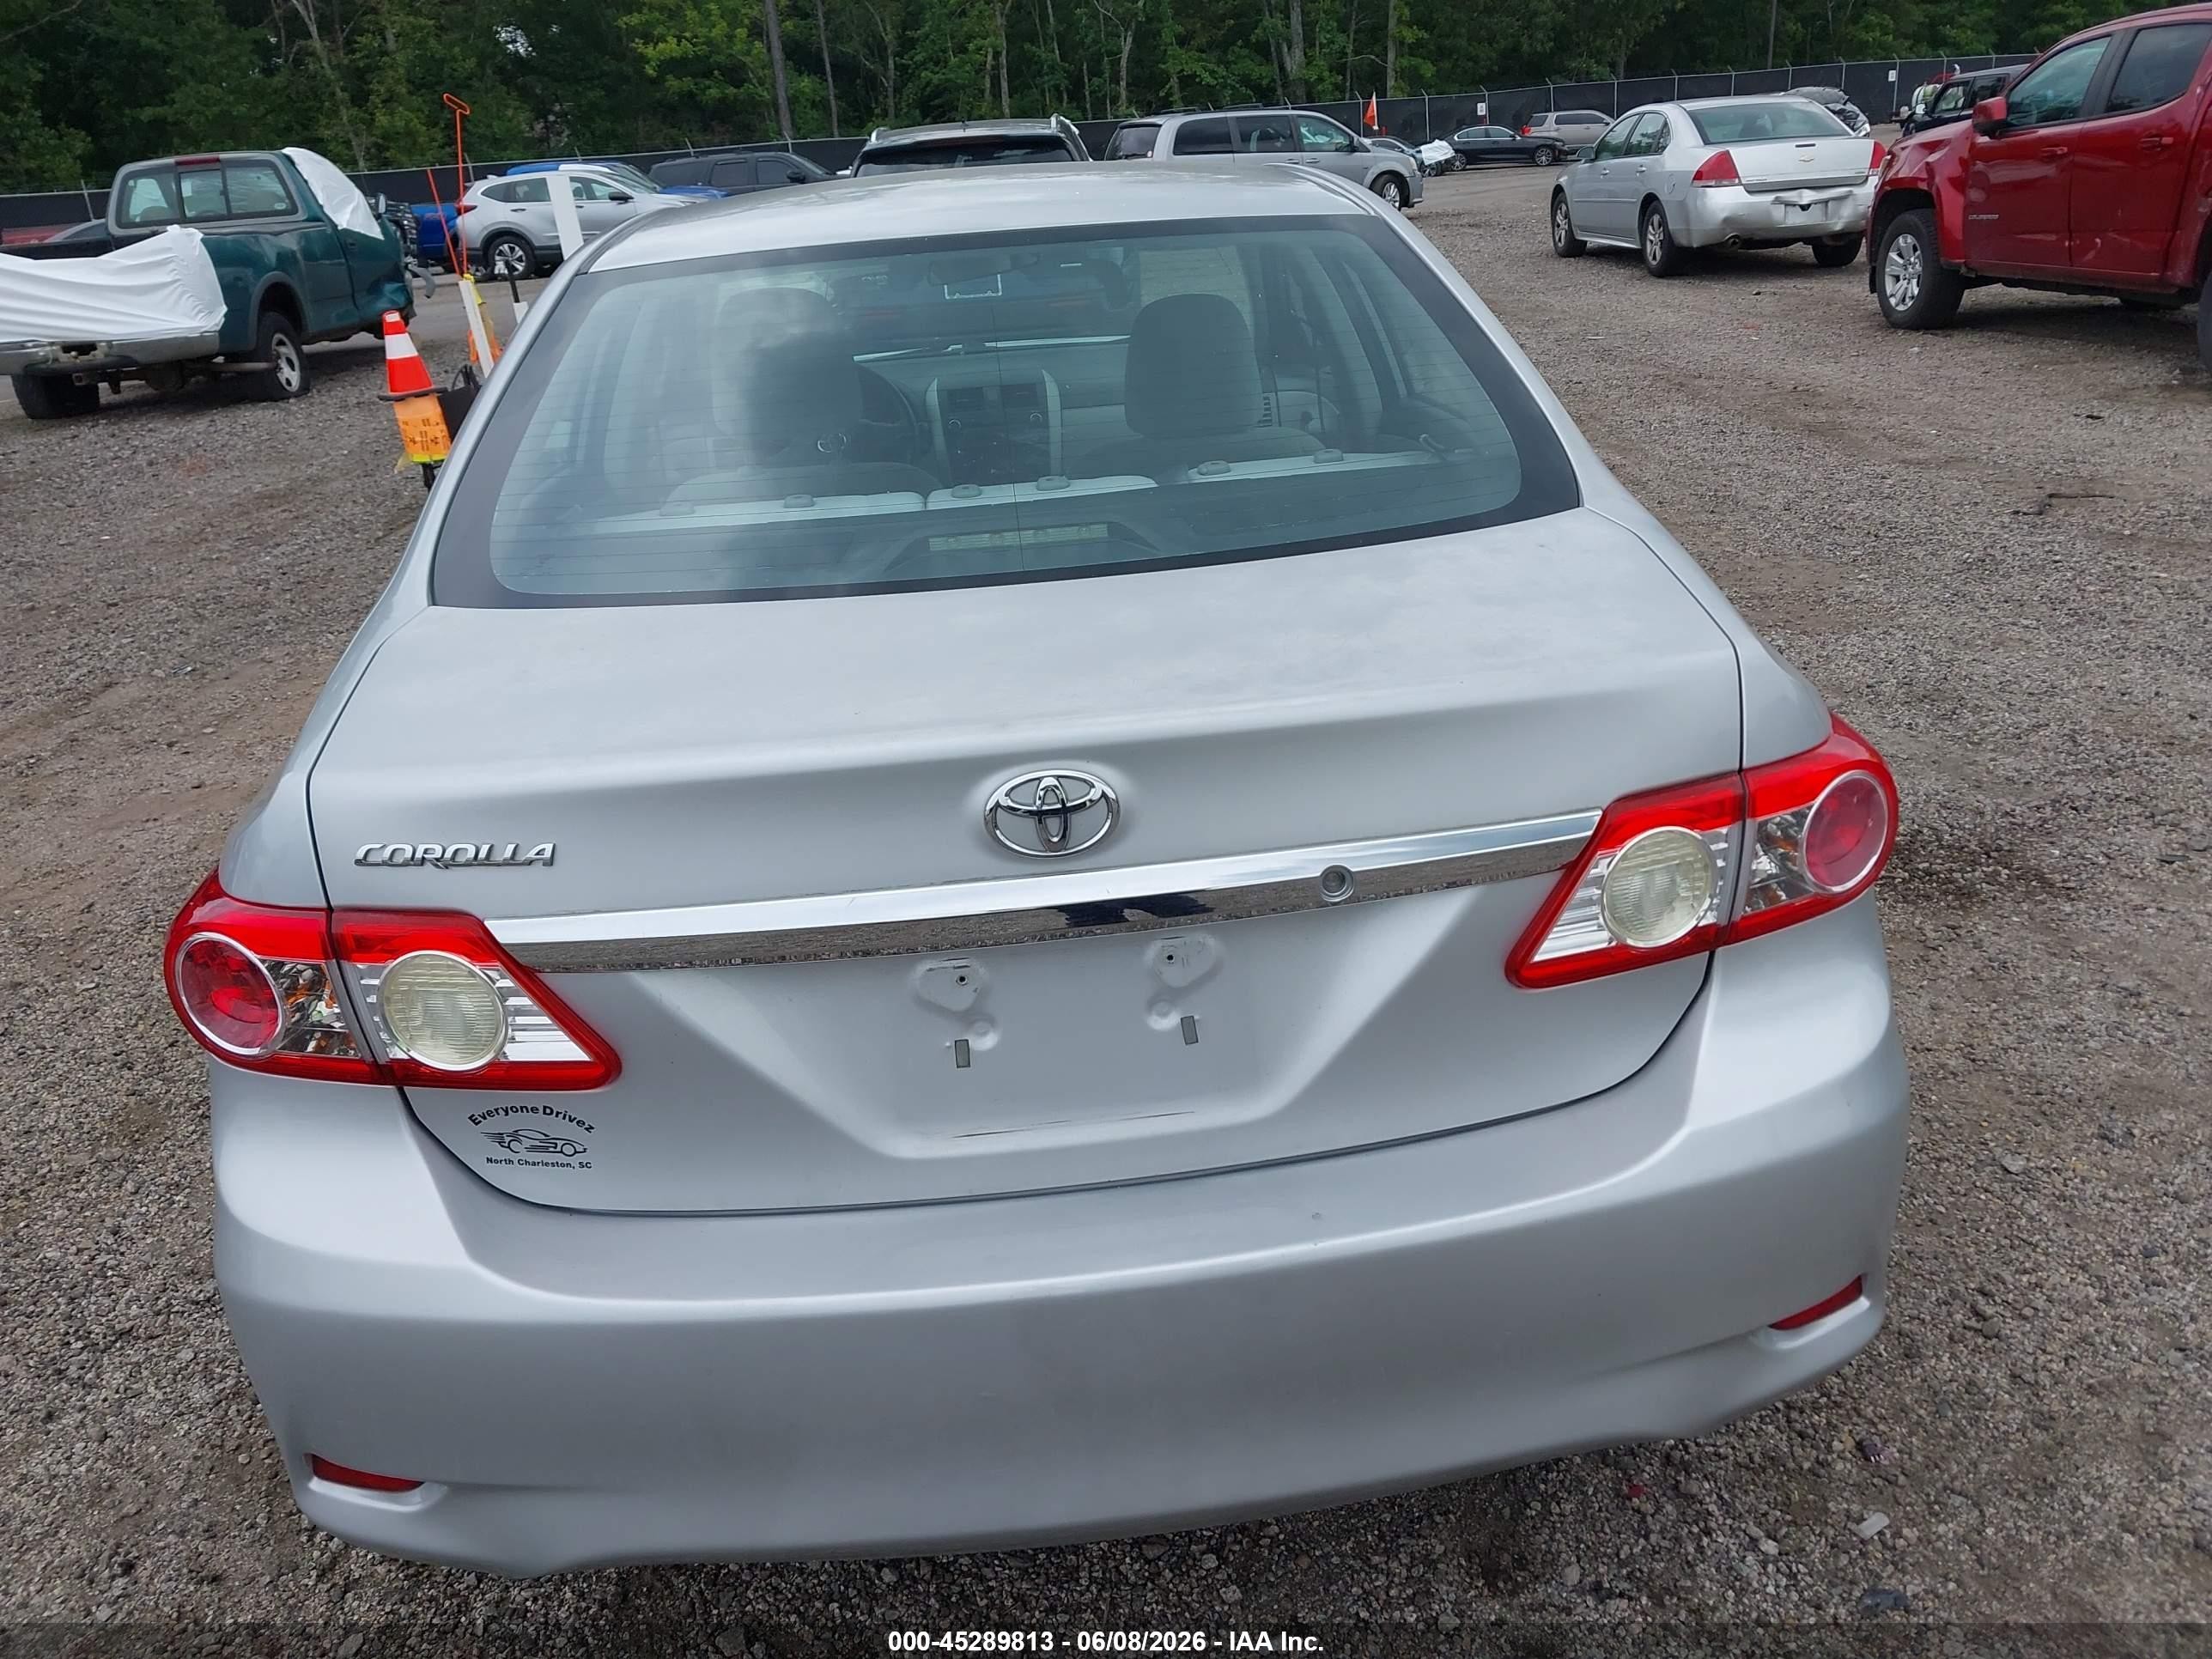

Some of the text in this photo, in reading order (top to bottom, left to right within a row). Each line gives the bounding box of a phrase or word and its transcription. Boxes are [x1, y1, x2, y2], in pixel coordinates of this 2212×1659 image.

[354, 842, 556, 869] COROLLA
[467, 1105, 595, 1133] Everyone Drivez
[486, 1157, 514, 1165] North
[517, 1158, 576, 1170] Charleston,
